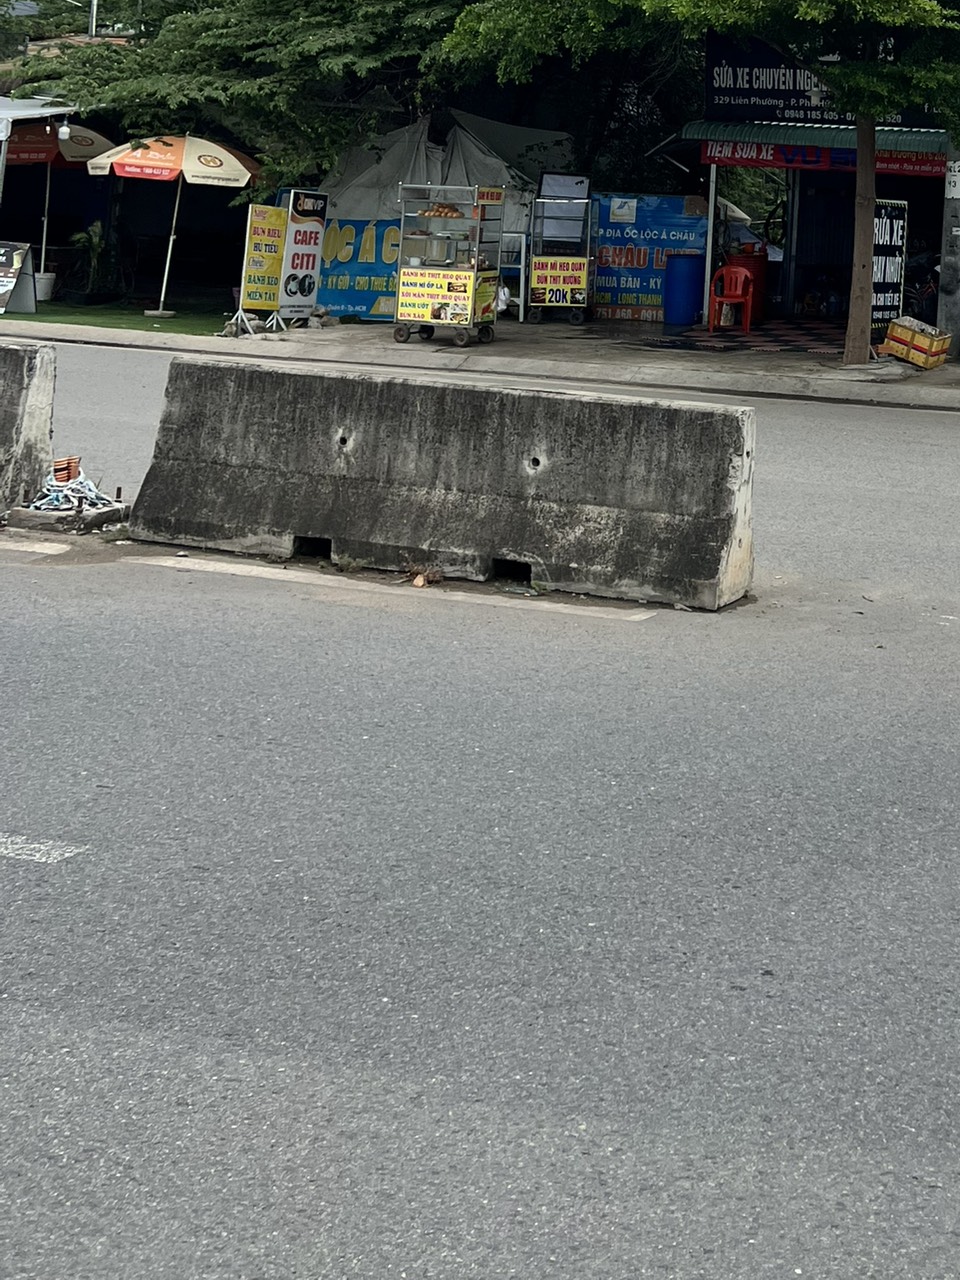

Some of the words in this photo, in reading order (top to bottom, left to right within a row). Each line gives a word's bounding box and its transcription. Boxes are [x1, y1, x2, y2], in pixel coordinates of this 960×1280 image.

[713, 60, 734, 88] SỬA
[736, 67, 749, 89] XE
[752, 64, 793, 90] CHUYÊN
[714, 96, 729, 104] 329
[731, 96, 748, 105] Liên
[751, 97, 784, 107] Phường
[807, 110, 821, 120] 185
[759, 144, 775, 160] XE
[294, 229, 320, 246] CAFE
[624, 226, 638, 238] ỐC
[640, 228, 659, 240] LỘC
[670, 230, 695, 240] CHÂU
[891, 219, 904, 246] XE
[291, 253, 317, 270] CITI
[598, 242, 650, 269] CHÂU
[559, 262, 569, 272] HEO
[571, 262, 586, 273] QUAY
[597, 276, 617, 288] MUA
[618, 292, 637, 304] LONG
